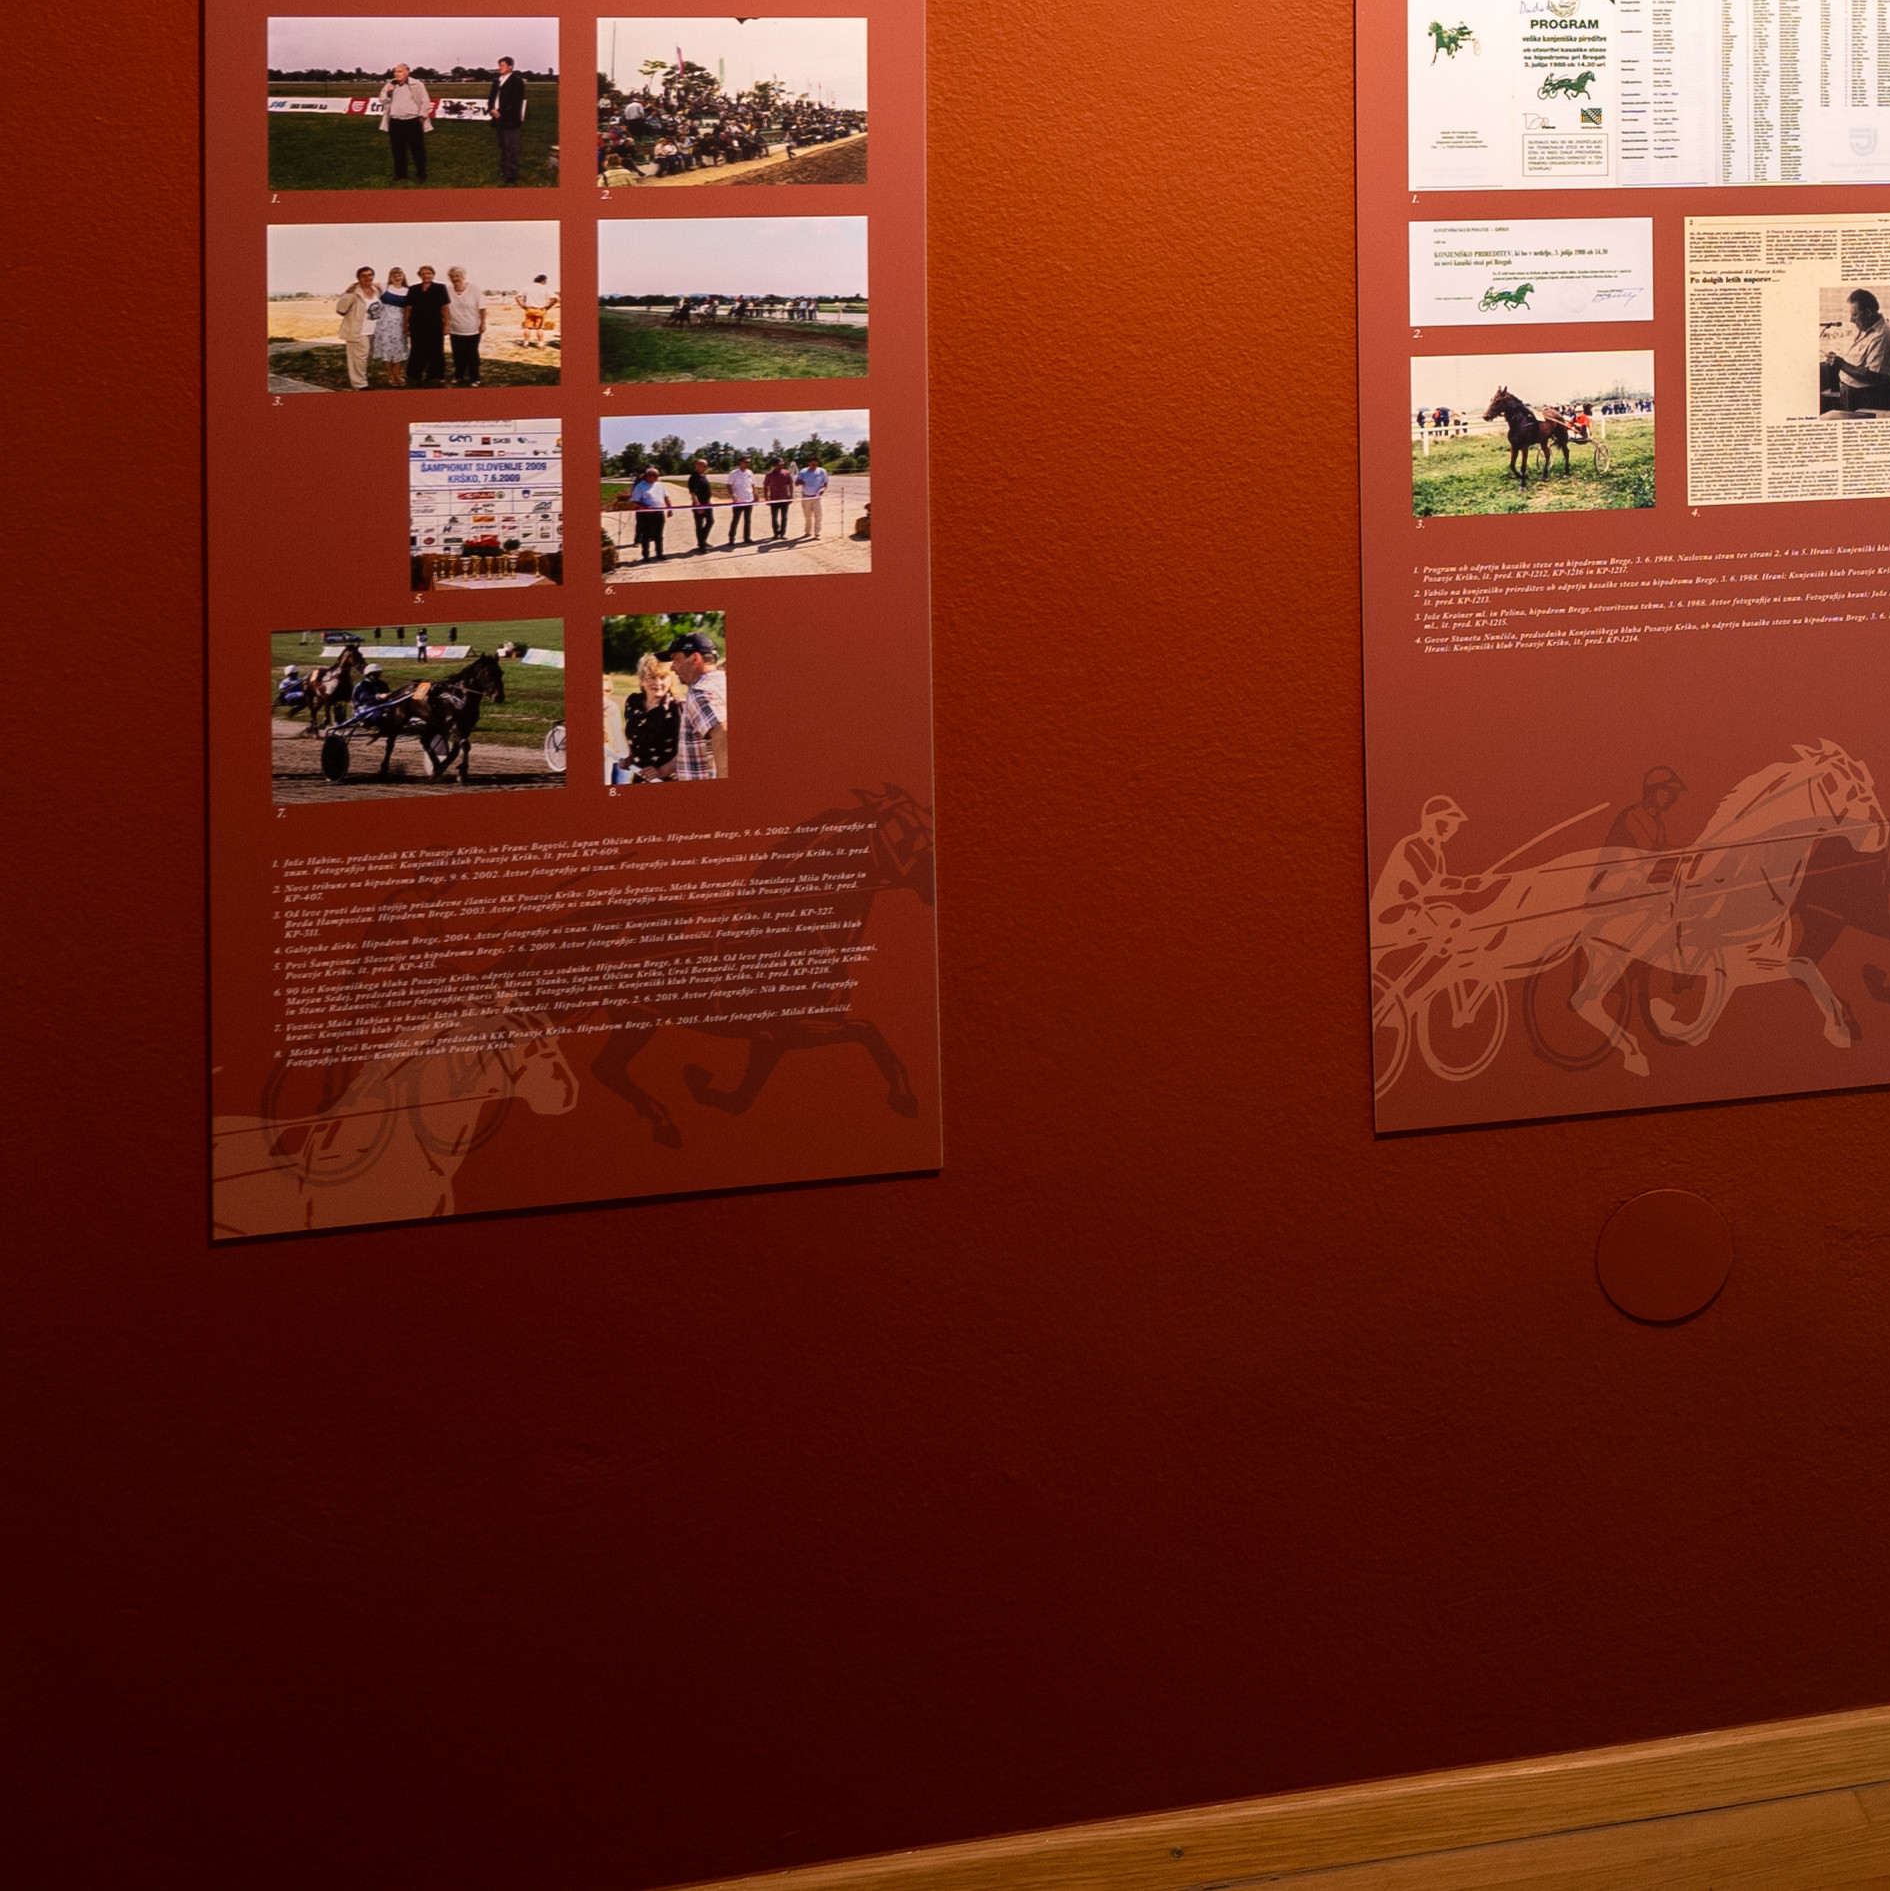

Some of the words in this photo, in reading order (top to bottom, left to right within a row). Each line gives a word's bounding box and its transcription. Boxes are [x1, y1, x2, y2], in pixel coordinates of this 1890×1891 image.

[1530, 19, 1599, 29] PROGRAM
[420, 462, 473, 472] ŠAMPIONAT
[475, 462, 523, 471] SLOVENIJE
[525, 462, 547, 470] 2009
[447, 473, 481, 484] KRŠKO,
